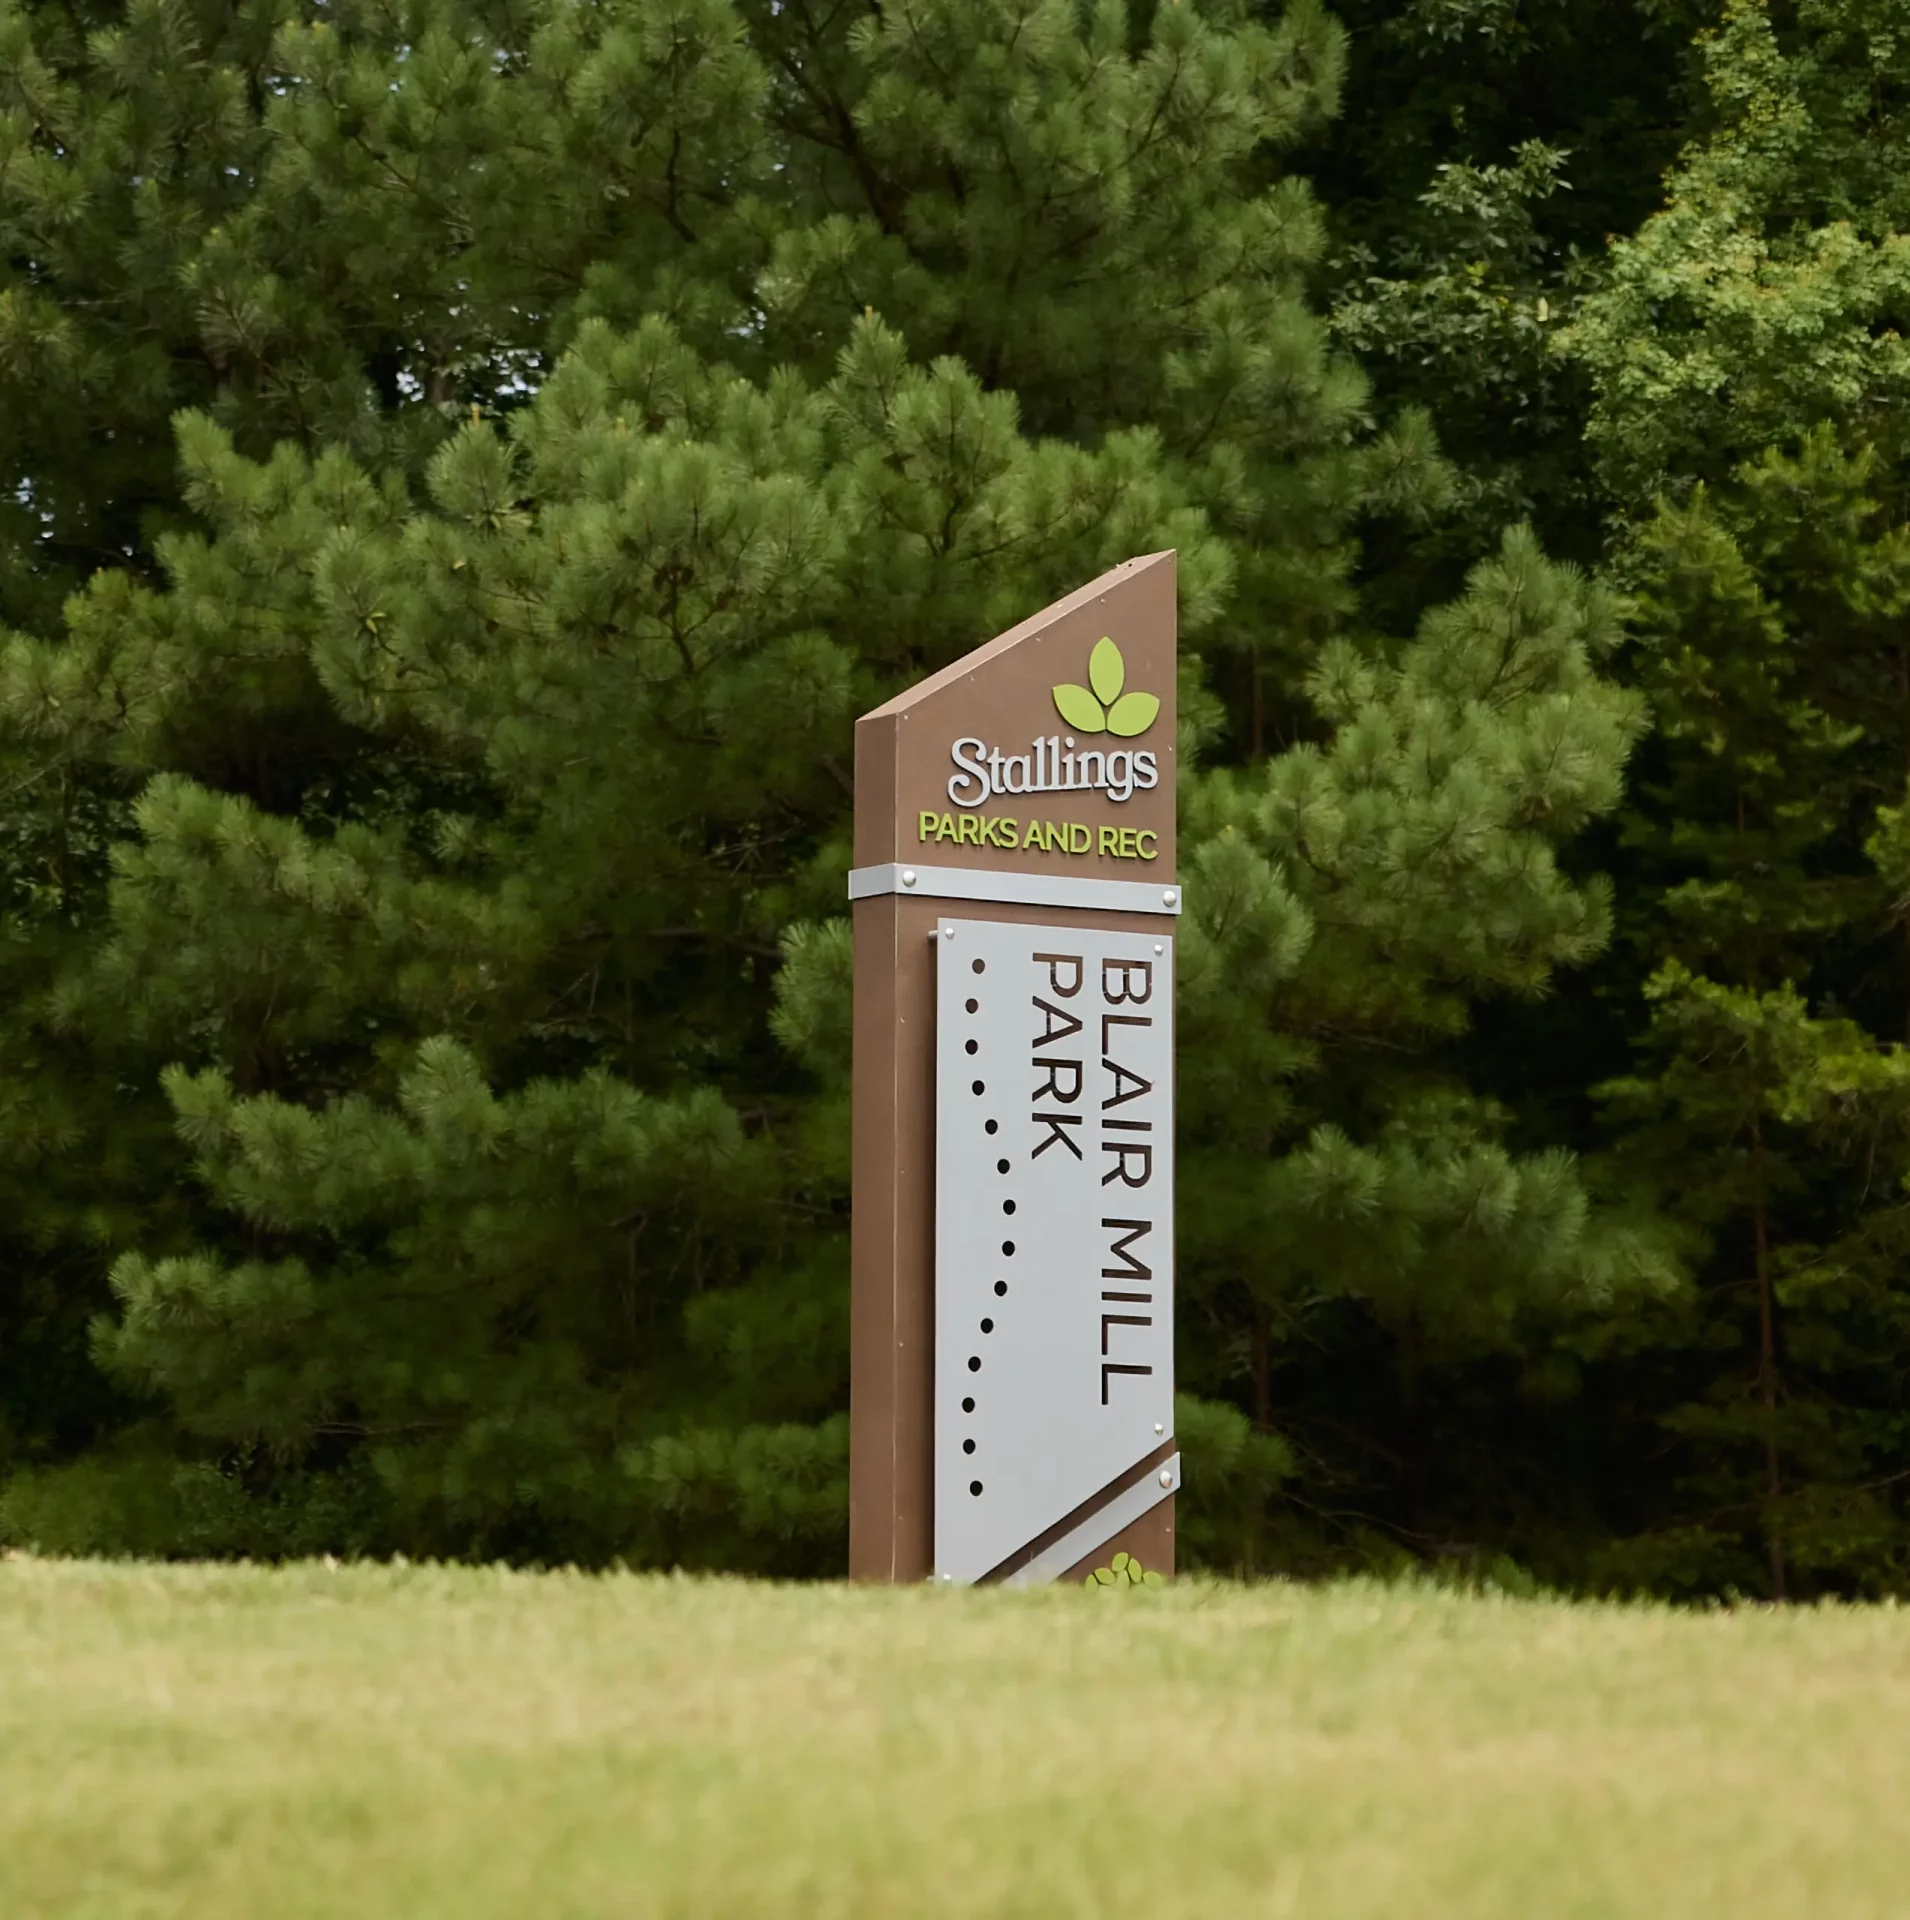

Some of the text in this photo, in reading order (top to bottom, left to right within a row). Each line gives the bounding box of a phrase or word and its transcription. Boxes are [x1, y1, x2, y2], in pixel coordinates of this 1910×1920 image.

[919, 811, 1158, 860] PARKS AND REC
[948, 736, 1158, 807] Stallings
[1032, 952, 1083, 1161] PARK
[1101, 958, 1153, 1405] BLAIR MILL
